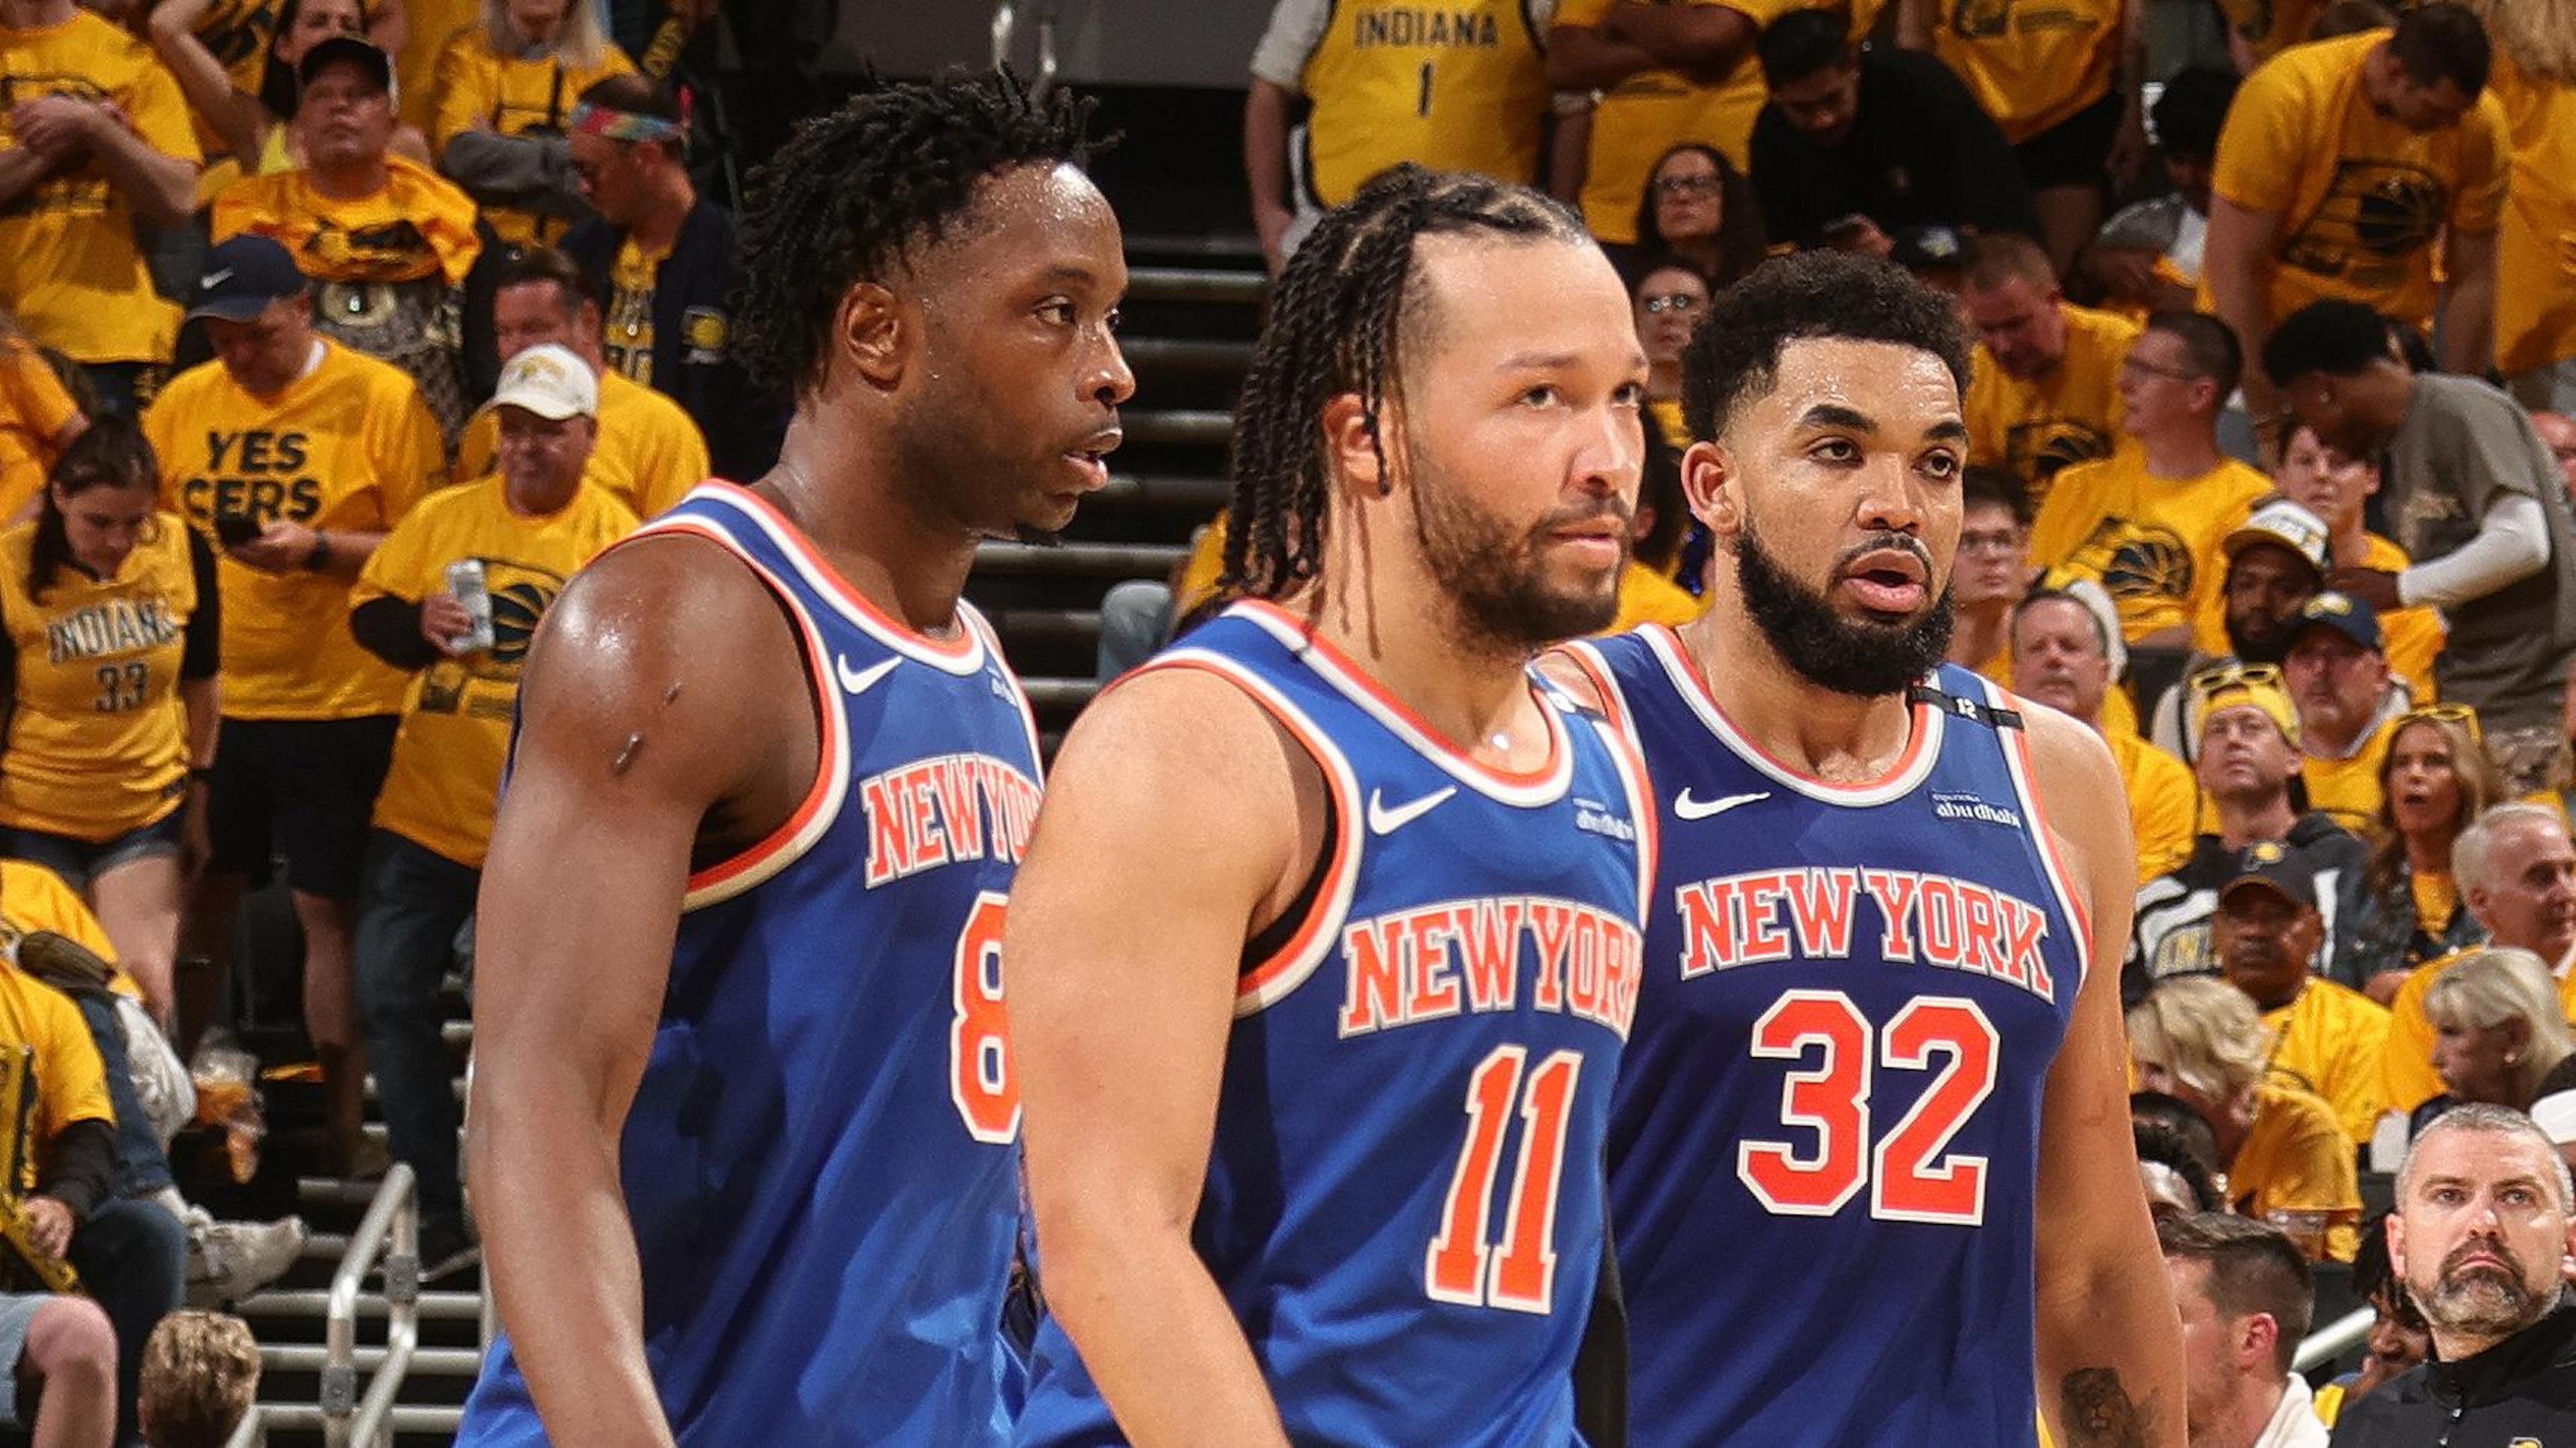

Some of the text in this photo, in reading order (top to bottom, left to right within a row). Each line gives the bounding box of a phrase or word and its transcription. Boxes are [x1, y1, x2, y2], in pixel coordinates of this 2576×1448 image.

[1354, 10, 1501, 48] INDIANA
[1417, 59, 1436, 119] 1
[208, 430, 309, 472] YES
[184, 478, 322, 522] CERS
[96, 660, 148, 712] 33
[1955, 698, 1978, 720] 12
[859, 753, 985, 890] NEW
[1937, 802, 1974, 818] abu
[1676, 866, 1862, 981] NEW
[1858, 865, 2055, 1005] YORK
[1338, 897, 1526, 1040] NEW
[950, 890, 1022, 1145] 8
[1737, 989, 2001, 1227] 32
[1426, 1043, 1585, 1316] 11
